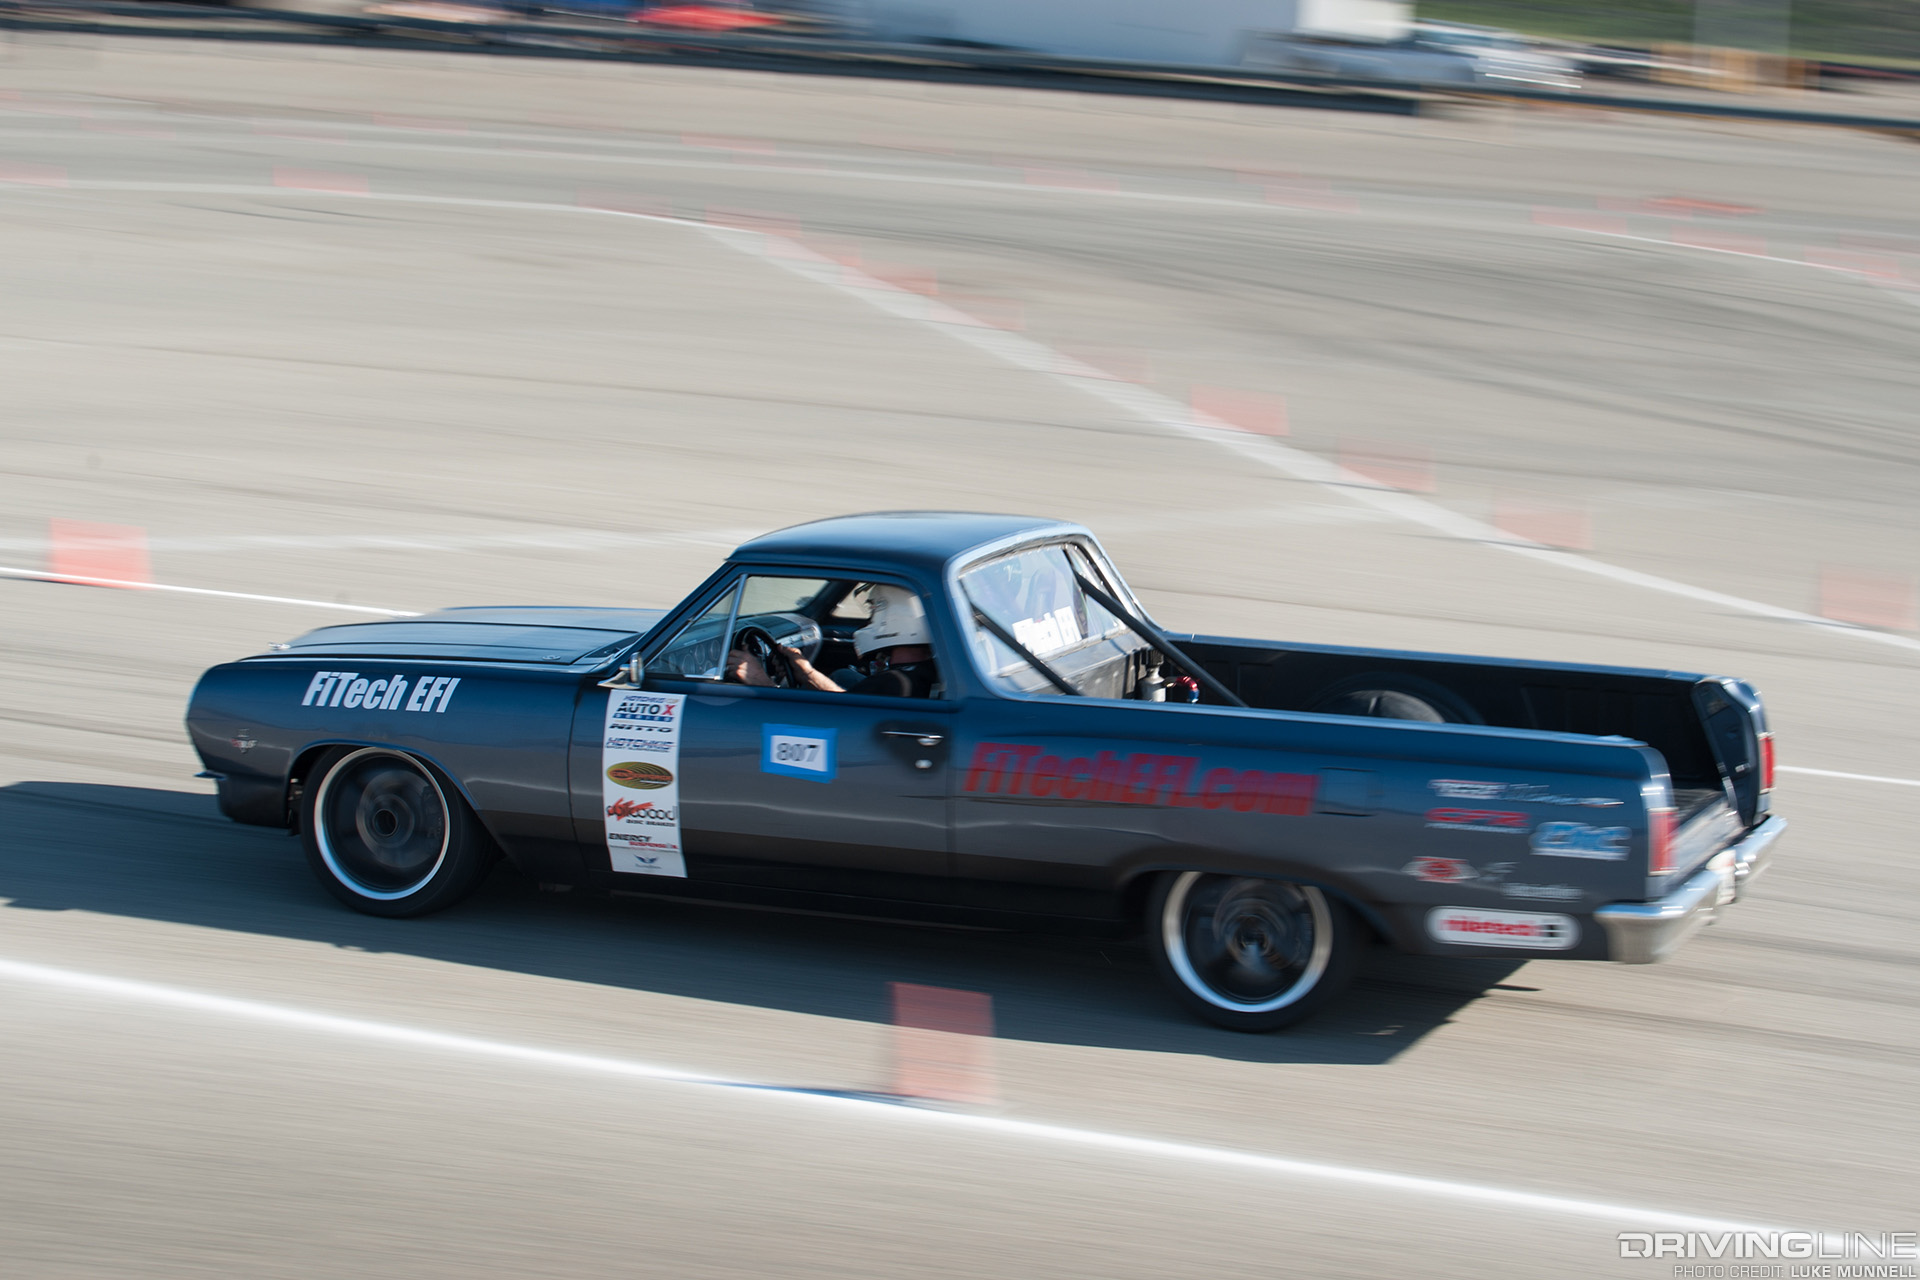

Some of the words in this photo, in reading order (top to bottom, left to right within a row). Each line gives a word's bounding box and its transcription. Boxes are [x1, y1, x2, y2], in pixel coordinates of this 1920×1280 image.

[302, 671, 408, 710] FiTech
[405, 676, 461, 713] EFI
[617, 702, 660, 714] AUTO
[661, 704, 676, 715] X
[609, 723, 673, 733] NITTO
[776, 743, 820, 762] 807
